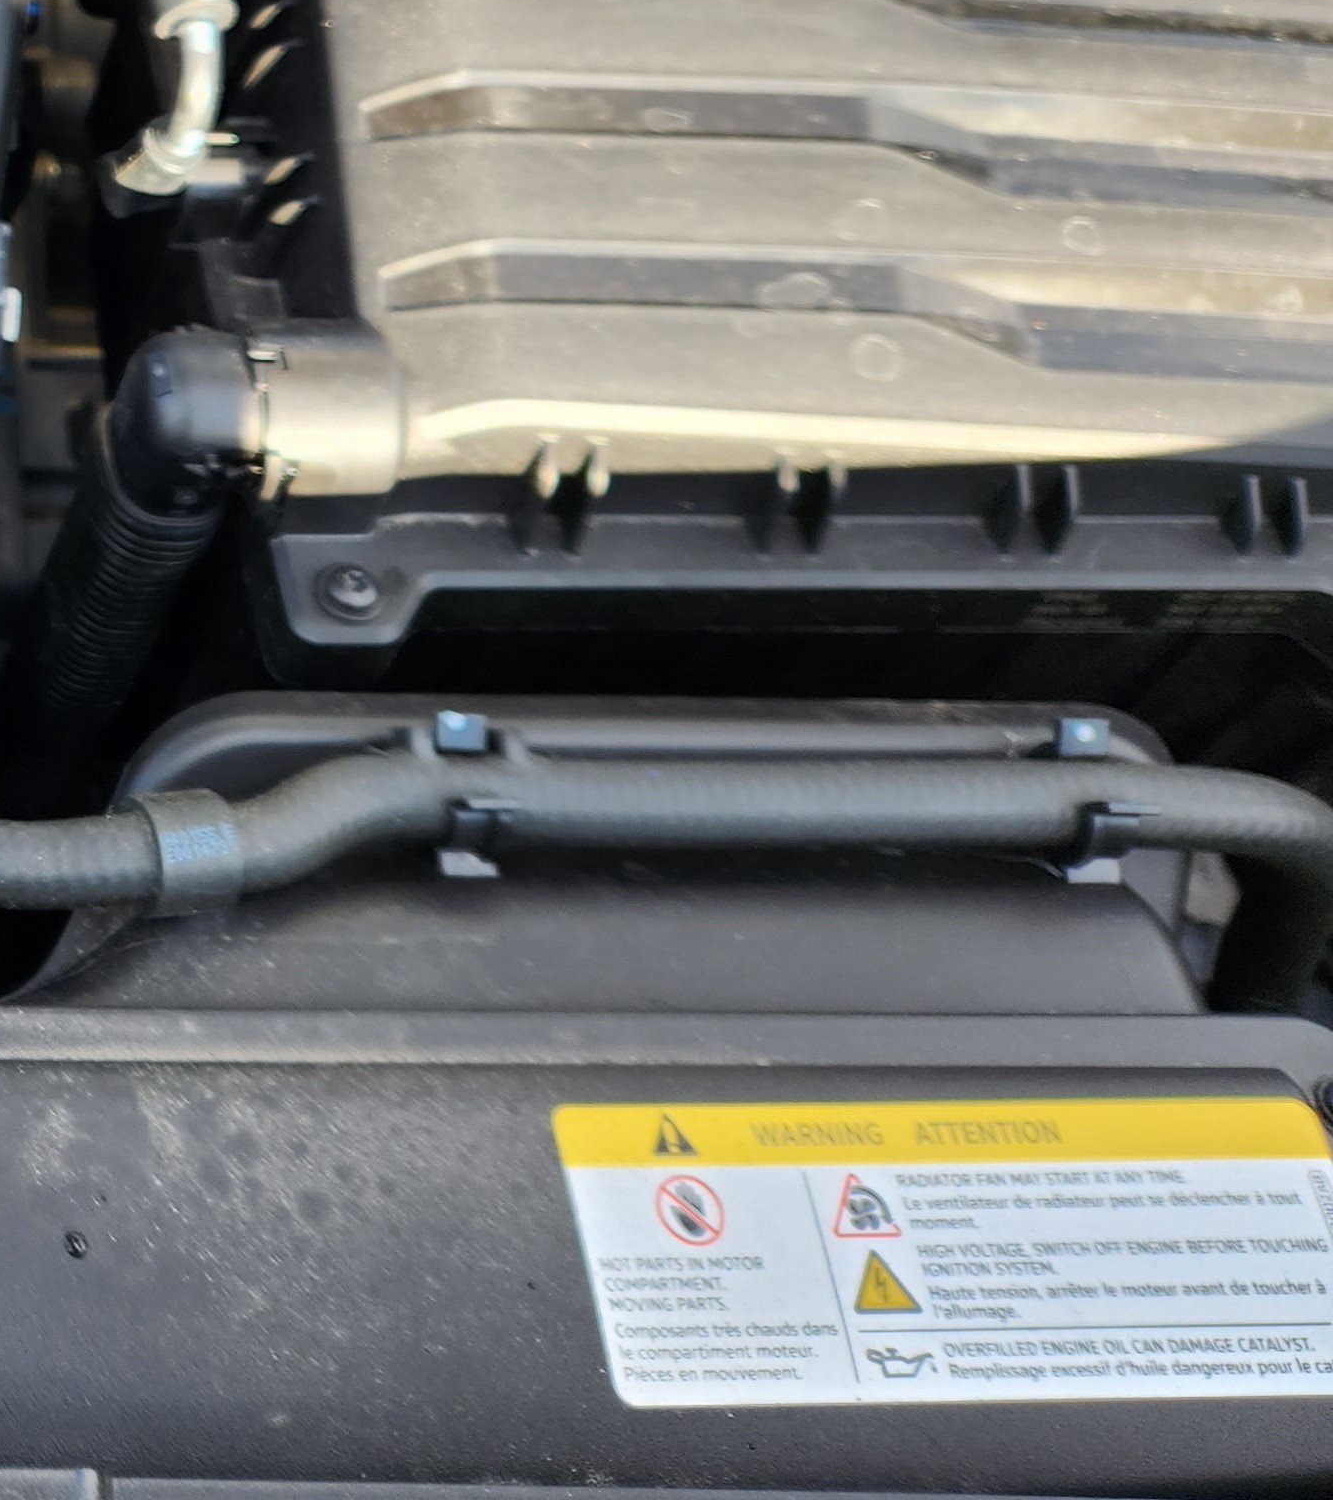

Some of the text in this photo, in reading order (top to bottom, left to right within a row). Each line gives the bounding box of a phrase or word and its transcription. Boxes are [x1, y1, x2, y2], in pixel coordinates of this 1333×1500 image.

[749, 1120, 1064, 1147] WARNING ATTENTION
[915, 1244, 955, 1259] HIGH
[1033, 1242, 1090, 1257] SWITCH
[1094, 1241, 1123, 1256] OFF
[1126, 1240, 1184, 1256] ENGINE
[1185, 1239, 1247, 1254] BEFORE
[1248, 1238, 1329, 1254] TOUCHING
[597, 1256, 766, 1272] HOT PARTS IN MOTOR
[921, 1262, 992, 1277] IGNITION
[927, 1284, 977, 1301] Haute
[1102, 1282, 1118, 1298] le
[1121, 1283, 1177, 1297] moteur
[1182, 1282, 1228, 1297] avant
[1229, 1279, 1250, 1296] de
[1251, 1278, 1313, 1295] toucher
[607, 1297, 673, 1312] MOVING
[615, 1322, 708, 1341] Composants
[745, 1321, 799, 1337] chauds
[801, 1321, 838, 1337] dans
[617, 1345, 634, 1360] le
[638, 1345, 753, 1362] compartiment
[941, 1337, 1316, 1357] OVERFILLED ENGINE OIL CAN DAMAGE CATALYST.
[679, 1369, 698, 1381] en
[948, 1361, 1048, 1382] Remplissage
[1050, 1360, 1112, 1377] excessif
[1169, 1359, 1254, 1379] dangereux
[1256, 1360, 1294, 1377] pour
[1295, 1358, 1312, 1374] le
[1313, 1359, 1333, 1374] ca
